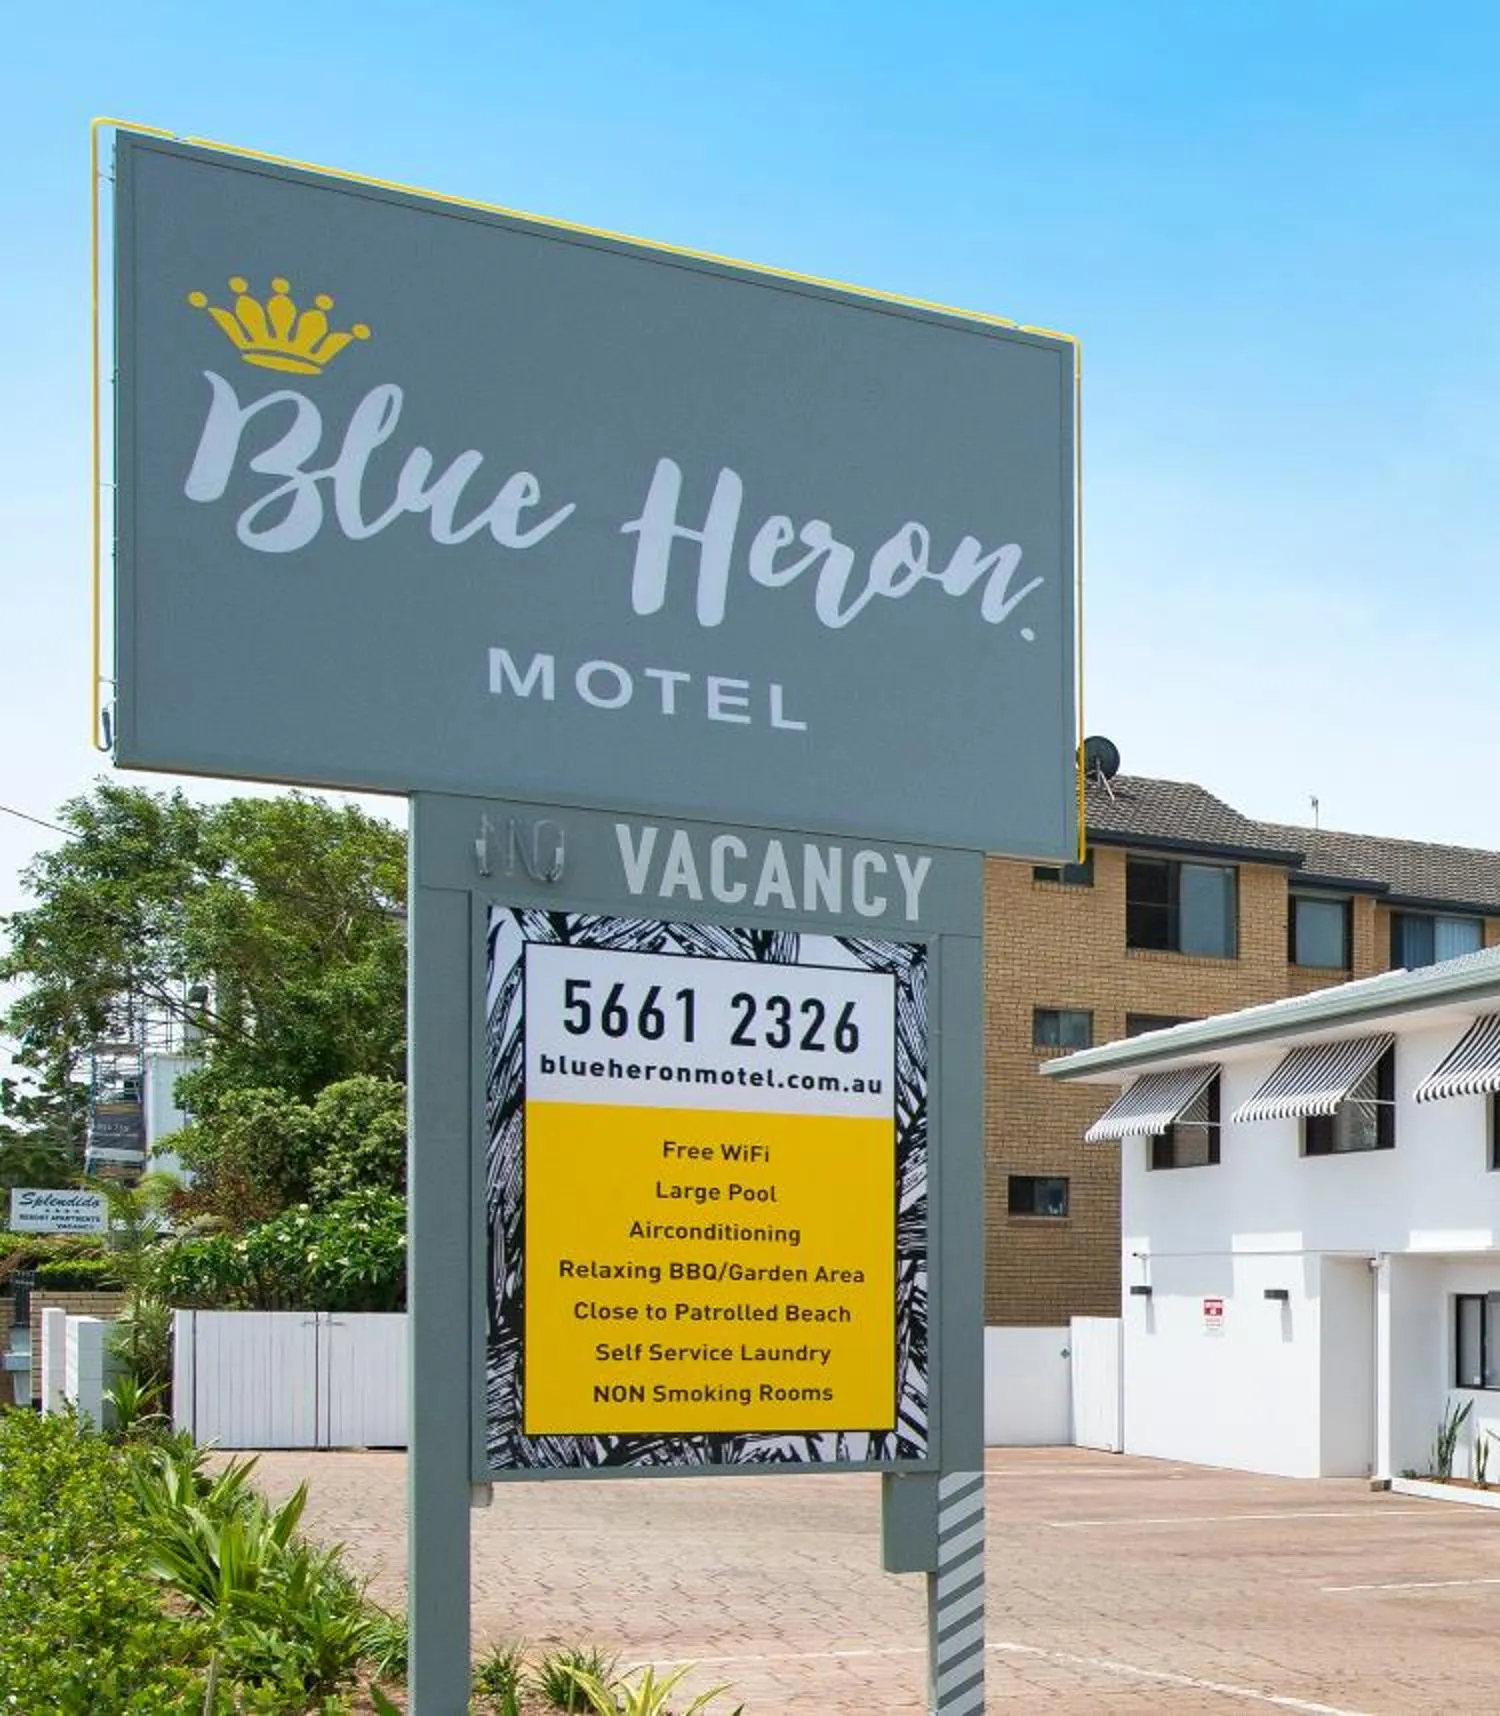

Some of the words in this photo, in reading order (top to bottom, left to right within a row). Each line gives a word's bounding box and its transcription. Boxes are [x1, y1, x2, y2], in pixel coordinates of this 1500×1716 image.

[184, 369, 577, 553] Blue
[488, 647, 808, 731] MOTEL
[614, 823, 932, 922] VACANCY
[563, 978, 695, 1043] 5661
[730, 992, 859, 1054] 2326
[540, 1053, 882, 1095] blueheronmotel.com.au
[662, 1141, 714, 1161] Free
[720, 1143, 770, 1163] WiFi
[18, 1191, 100, 1209] Splendido
[655, 1180, 721, 1205] Large
[728, 1183, 778, 1203] Pool
[628, 1220, 801, 1247] Airconditioning
[559, 1259, 662, 1284] Relaxing
[669, 1262, 808, 1284] BBQ/Garden
[813, 1265, 865, 1284] Area
[573, 1301, 639, 1321] Close
[645, 1303, 668, 1321] to
[674, 1302, 779, 1322] Patrolled
[785, 1304, 852, 1323] Beach
[595, 1343, 643, 1362] Self
[648, 1343, 734, 1362] Service
[740, 1343, 832, 1366] Laundry
[593, 1384, 646, 1404] NON
[652, 1384, 752, 1407] Smoking
[759, 1383, 834, 1402] Rooms
